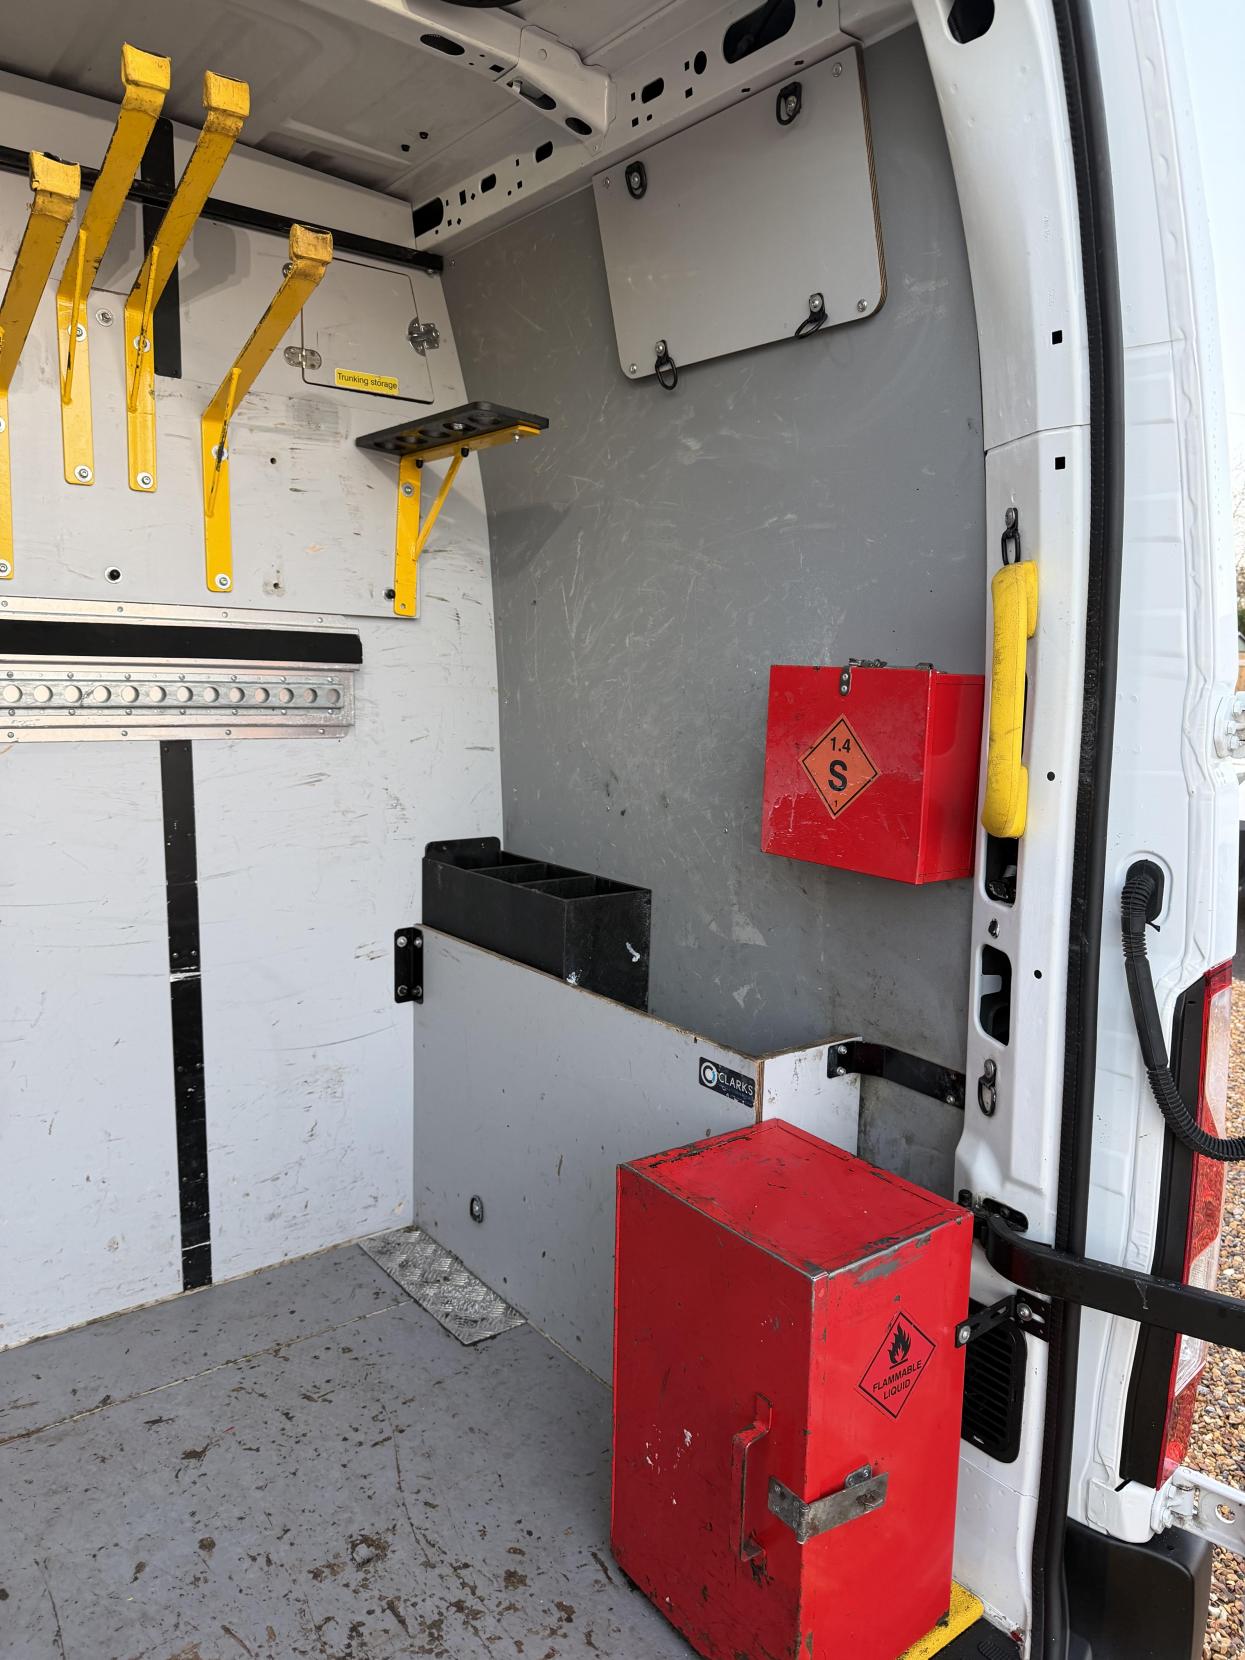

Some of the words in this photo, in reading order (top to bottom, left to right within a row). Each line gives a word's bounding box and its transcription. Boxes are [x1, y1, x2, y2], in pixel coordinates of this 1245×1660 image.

[337, 372, 369, 386] Trunking
[370, 379, 398, 390] storage
[830, 736, 851, 753] 1.4
[828, 759, 848, 792] S
[718, 1072, 754, 1096] CLARKS
[872, 1359, 922, 1392] FLAMMABLE
[883, 1378, 911, 1400] LIQUID
